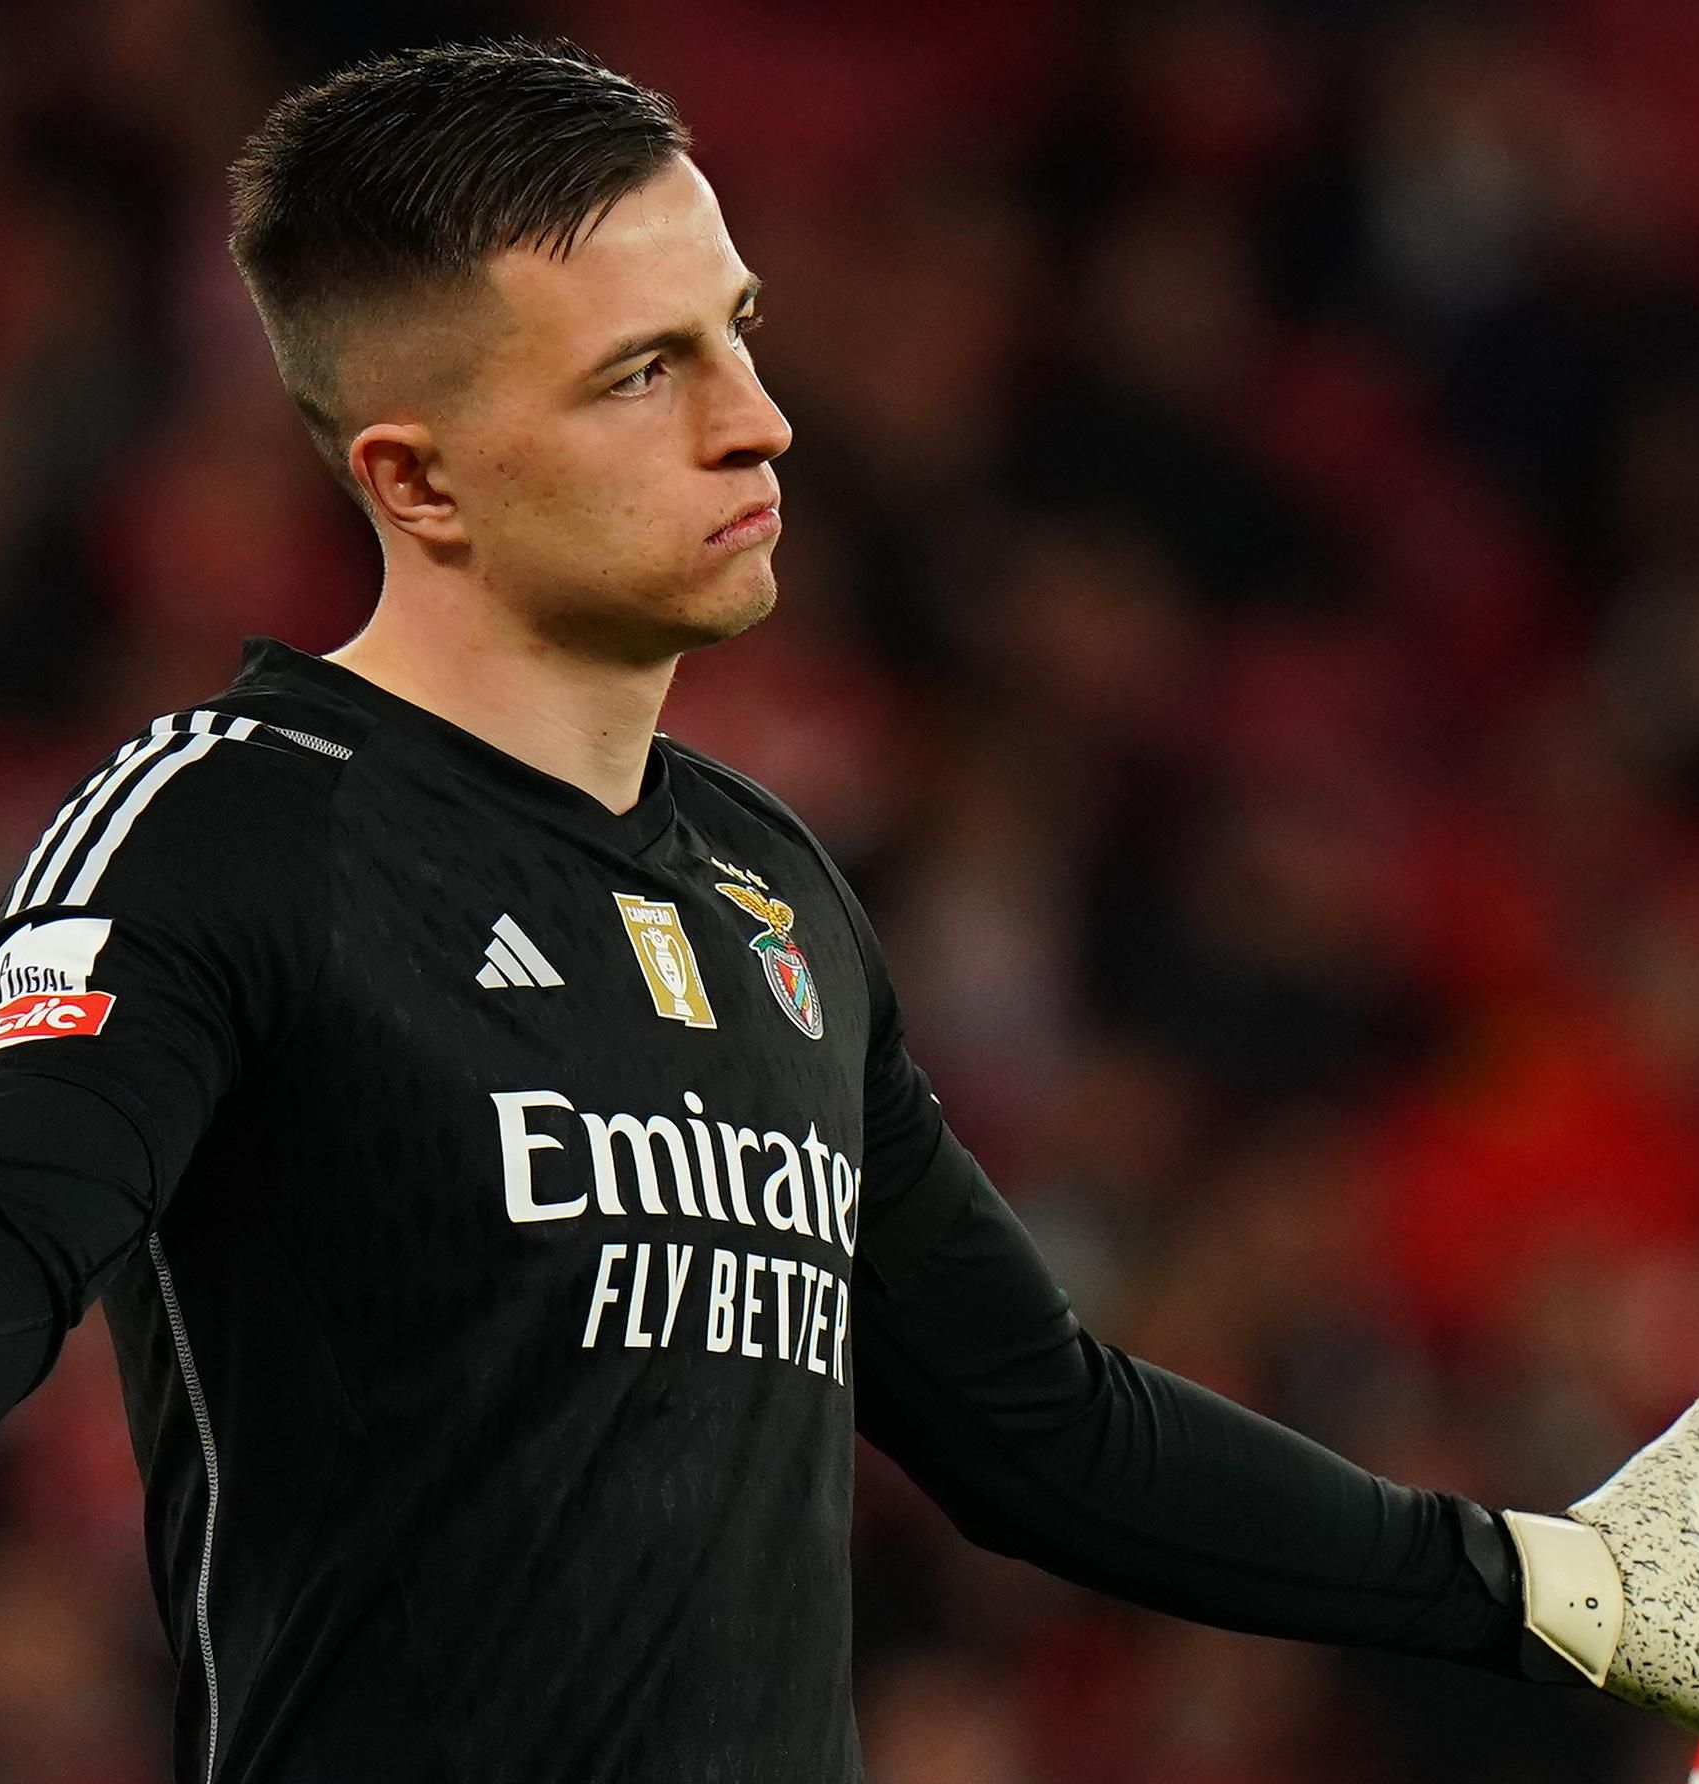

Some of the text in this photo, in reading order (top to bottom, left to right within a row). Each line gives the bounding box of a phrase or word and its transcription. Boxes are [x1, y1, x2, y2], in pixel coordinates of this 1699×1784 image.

[489, 1089, 863, 1258] Emirate
[582, 1243, 847, 1387] FLY BETTER
